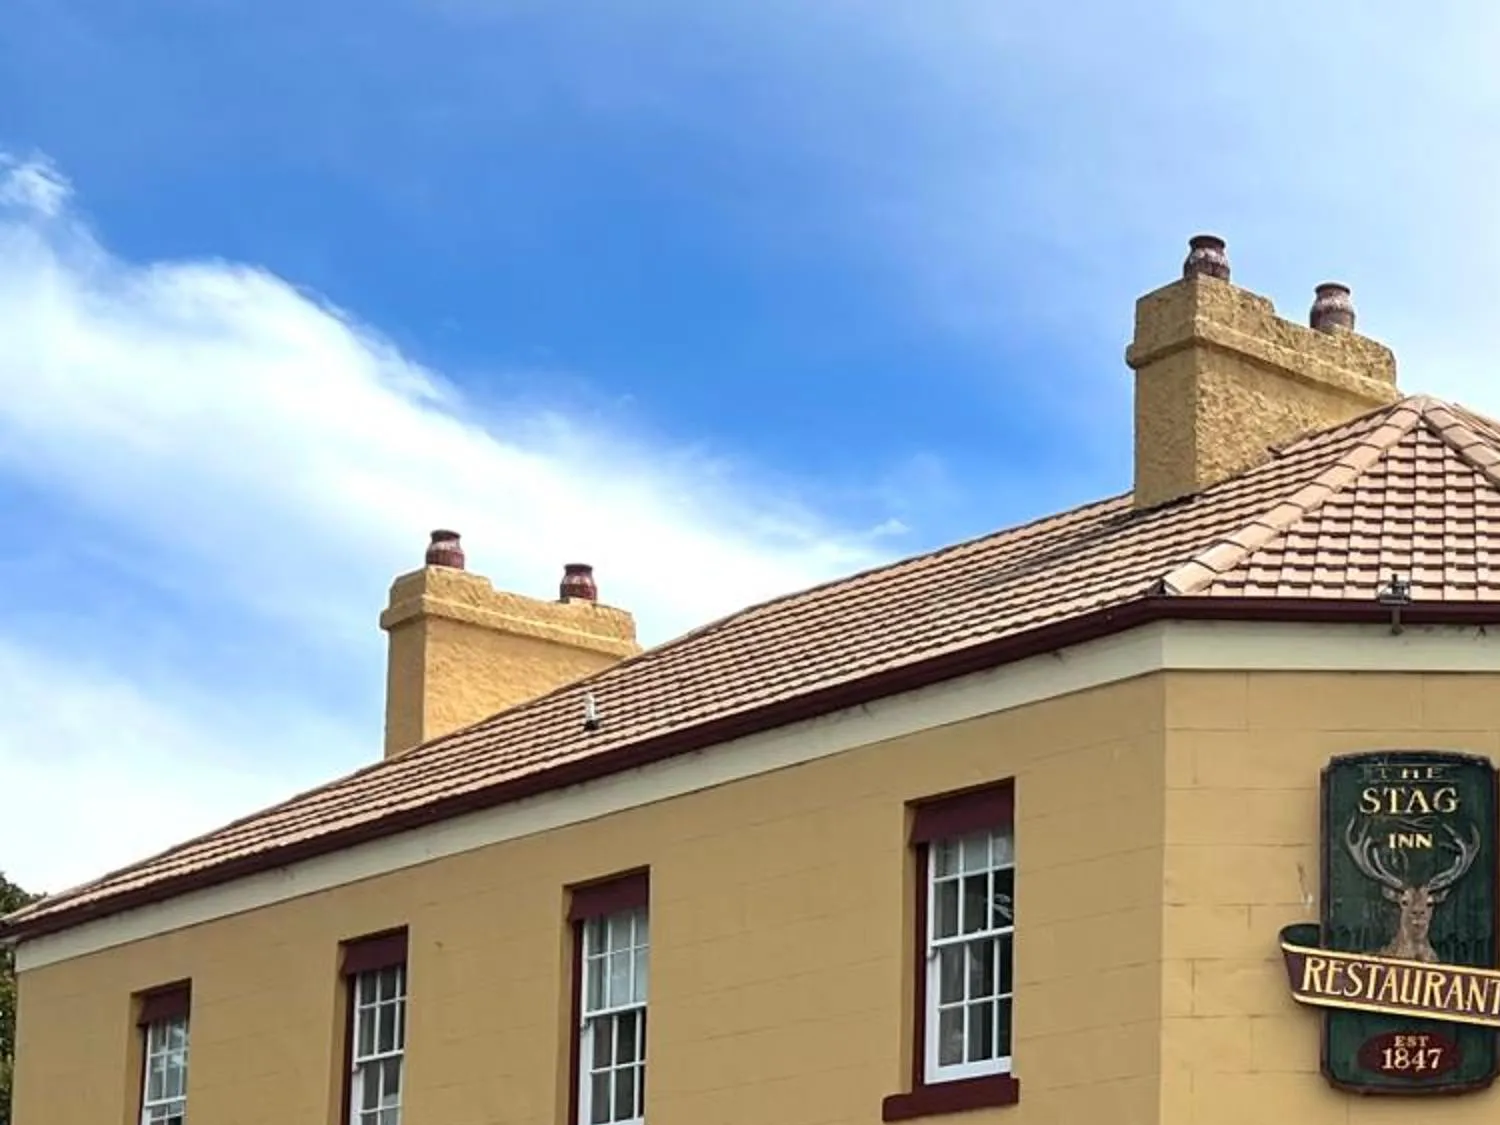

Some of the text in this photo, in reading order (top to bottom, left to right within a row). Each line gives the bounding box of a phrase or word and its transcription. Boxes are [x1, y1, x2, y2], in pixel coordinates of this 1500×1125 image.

[1375, 766, 1443, 779] THE
[1359, 787, 1460, 814] STAG
[1388, 833, 1433, 849] INN
[1394, 1035, 1430, 1047] EST
[1381, 1048, 1443, 1070] 1847
